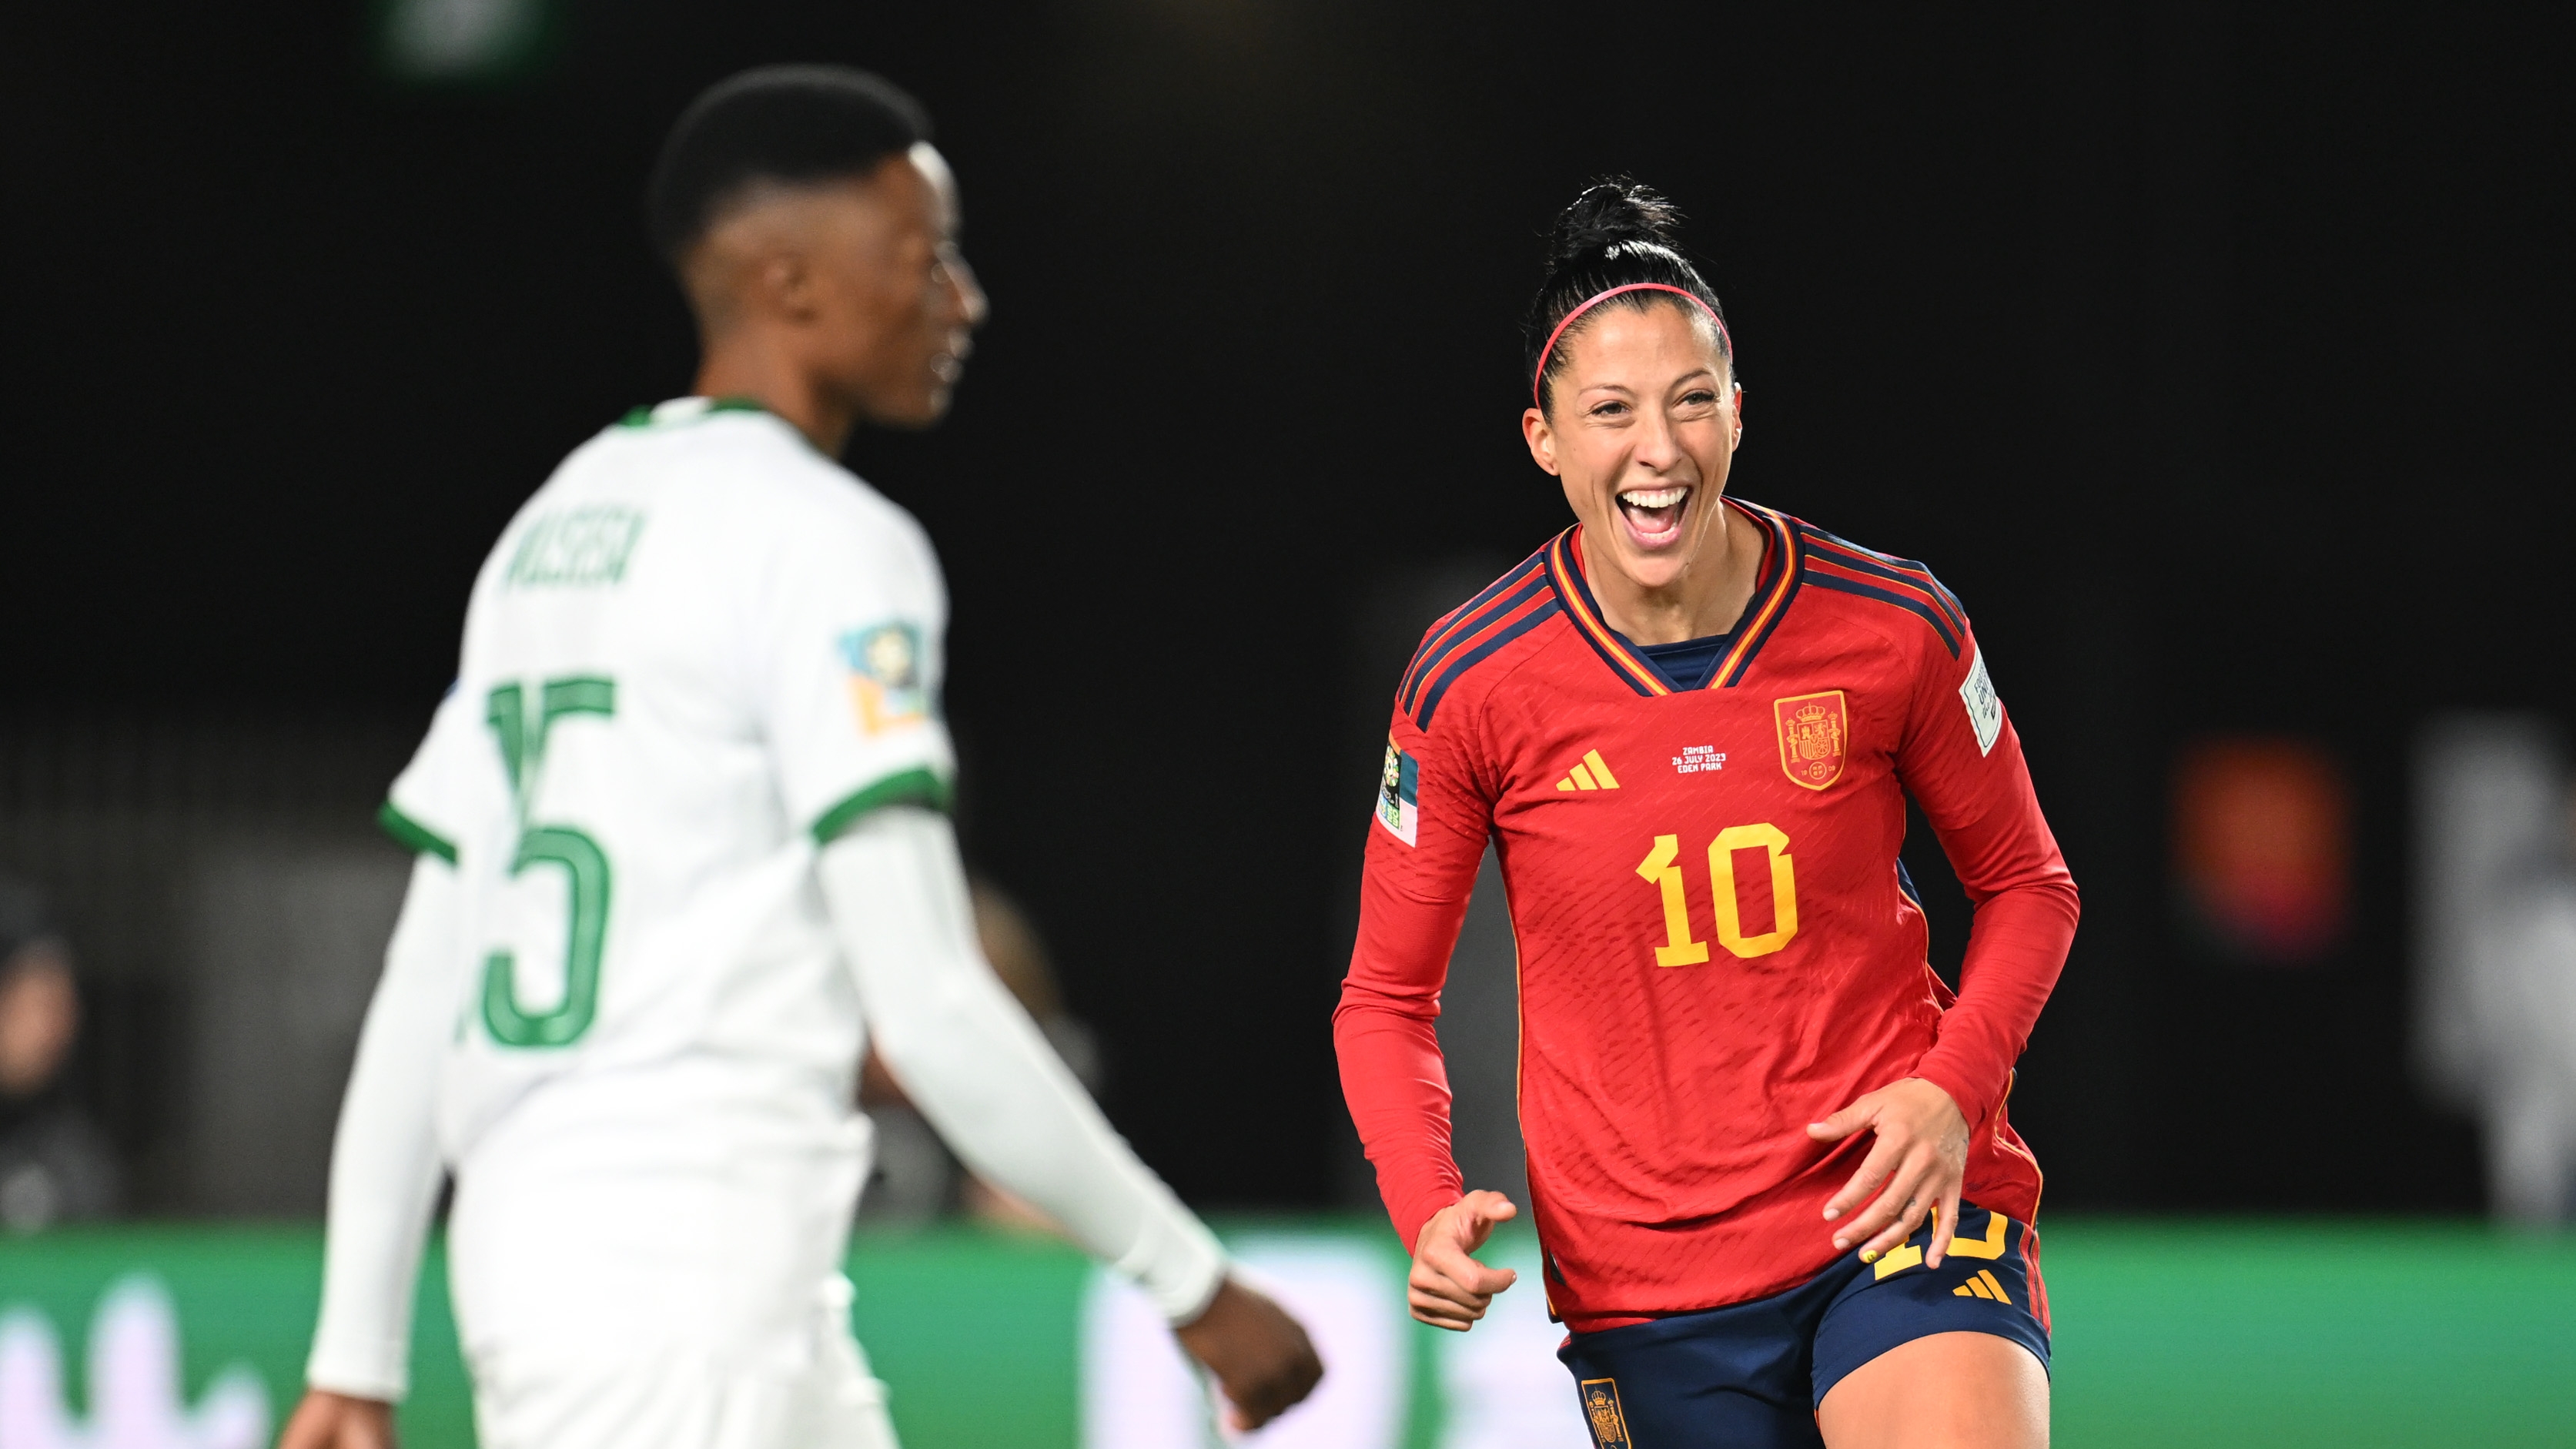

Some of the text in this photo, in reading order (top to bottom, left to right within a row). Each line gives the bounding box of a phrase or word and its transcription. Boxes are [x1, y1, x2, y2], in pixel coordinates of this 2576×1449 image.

[1682, 745, 1714, 755] ZAMBIA
[1671, 753, 1726, 766] 26 JULY 2023
[1677, 761, 1722, 774] EDEN PARK
[1635, 822, 1798, 967] 10
